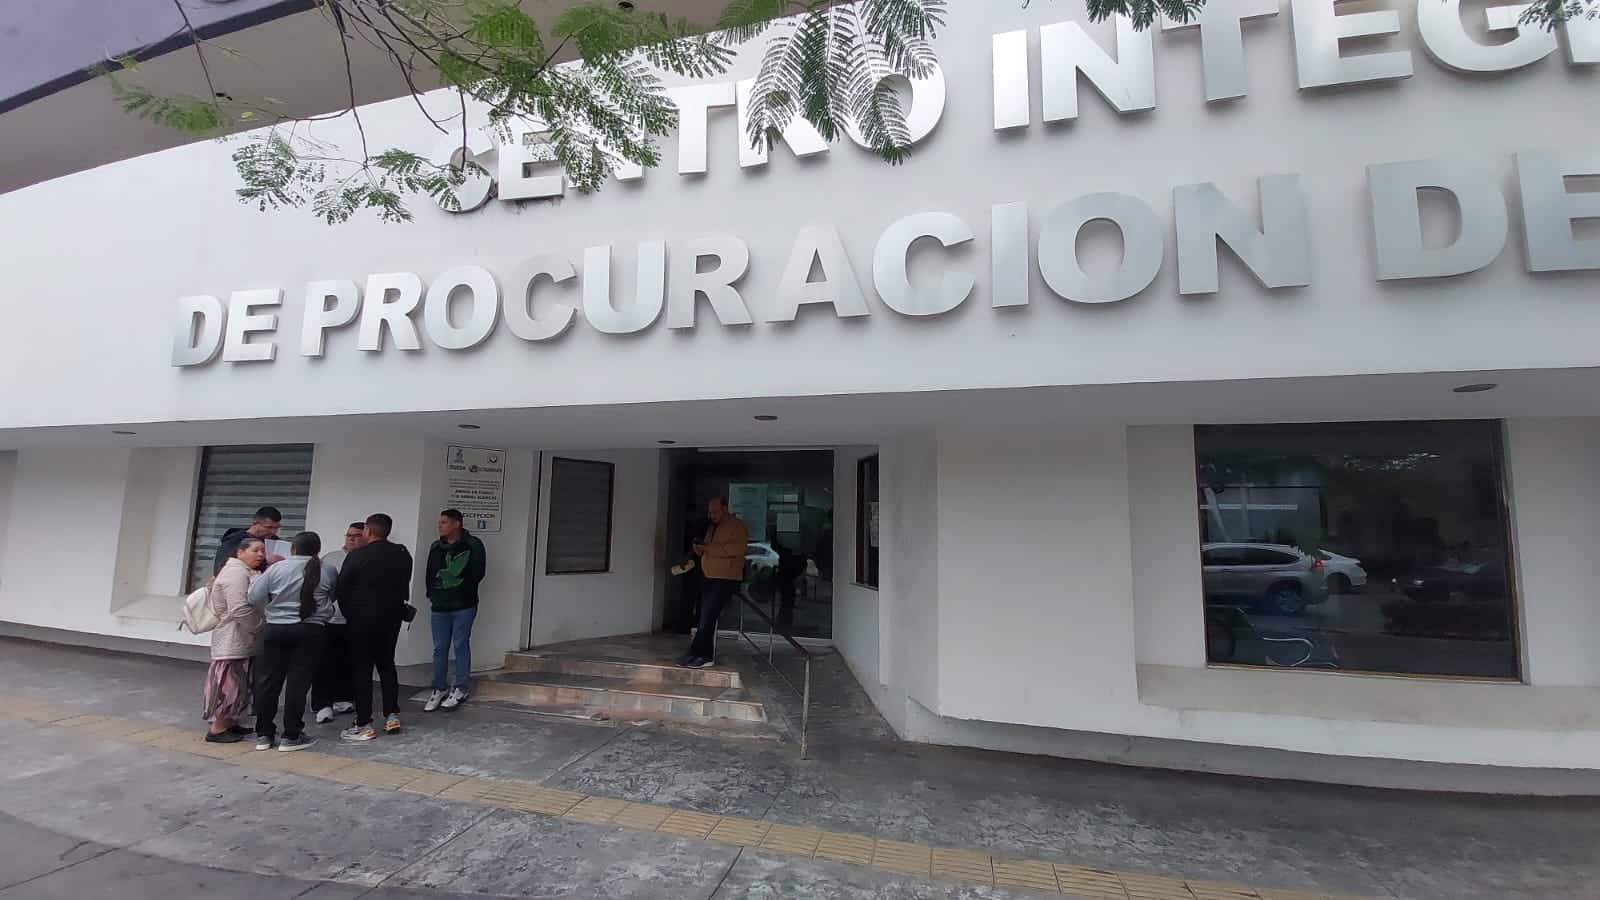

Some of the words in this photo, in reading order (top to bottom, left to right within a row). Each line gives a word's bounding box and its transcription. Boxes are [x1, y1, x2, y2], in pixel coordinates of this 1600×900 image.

[993, 0, 1600, 130] INTEG
[171, 288, 284, 368] DE
[302, 173, 1311, 357] PROCURACION
